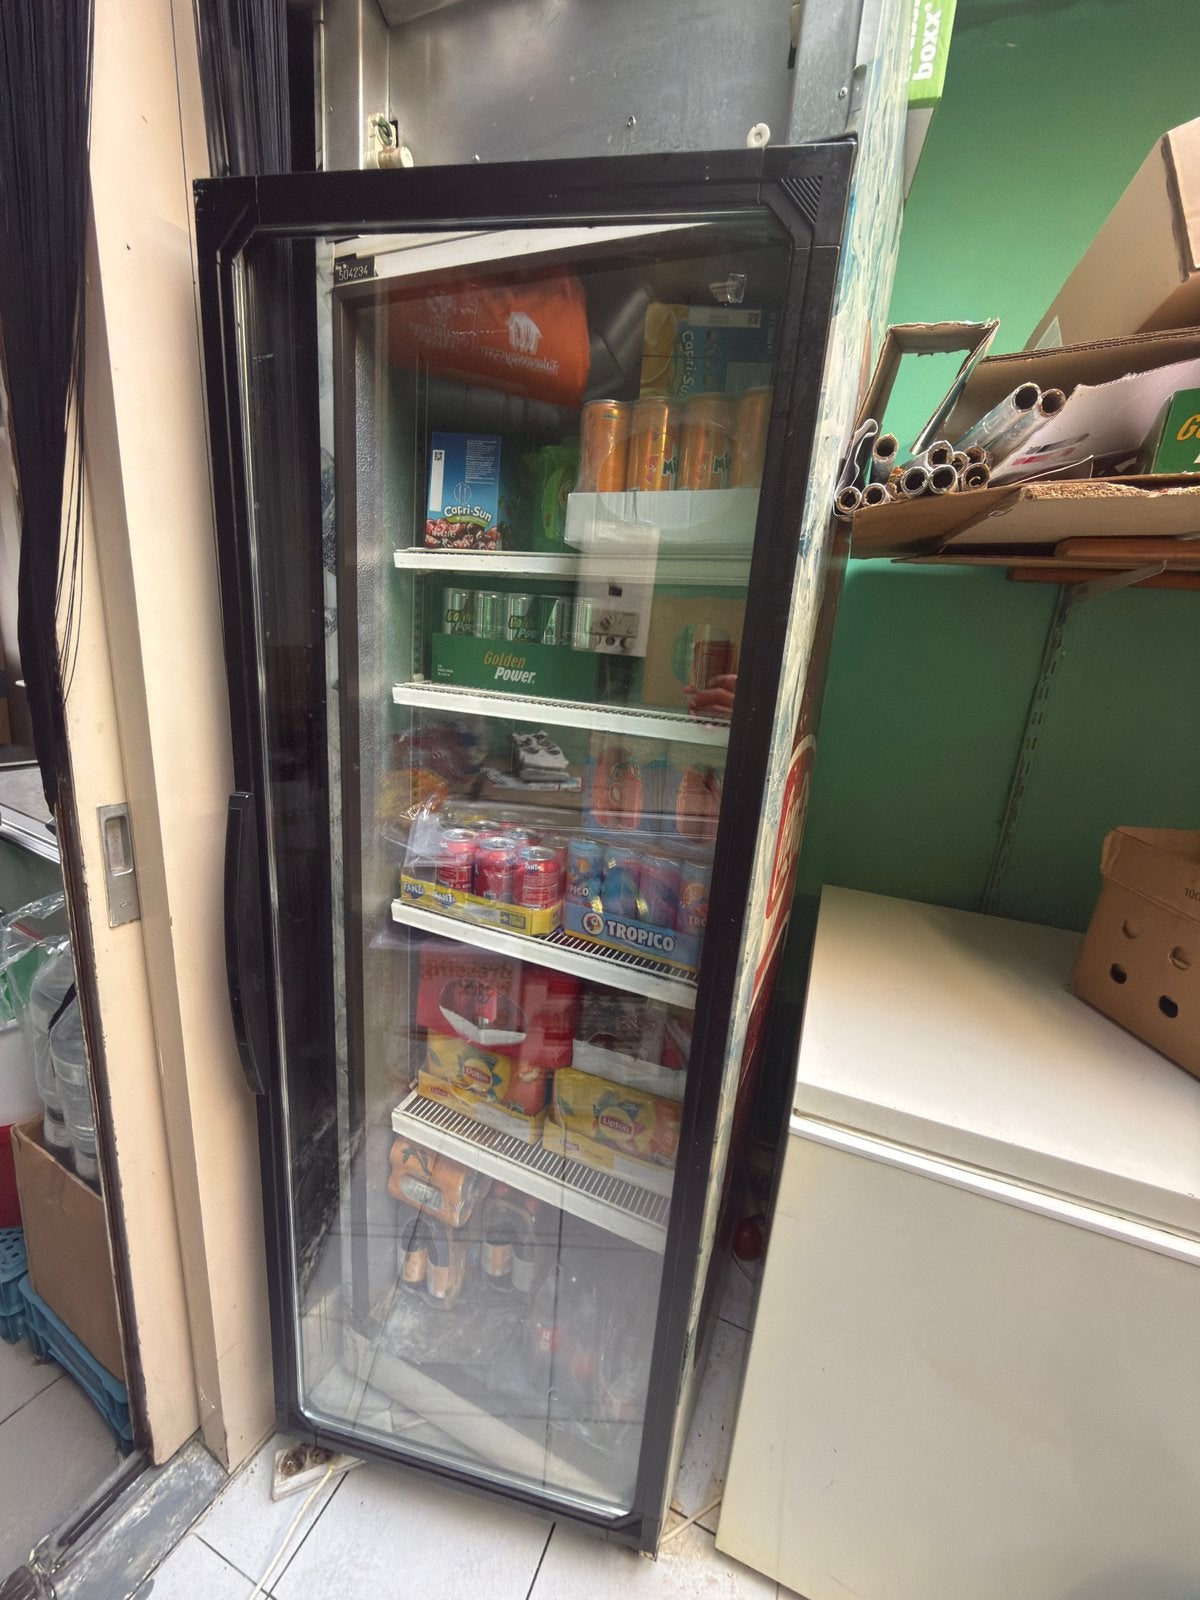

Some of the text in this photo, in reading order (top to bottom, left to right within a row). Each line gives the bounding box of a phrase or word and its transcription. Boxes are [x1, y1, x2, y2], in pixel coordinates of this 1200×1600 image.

[912, 9, 942, 81] boxx
[339, 265, 368, 281] 504234
[444, 504, 493, 522] Capri-Sun
[484, 650, 526, 669] Golden
[494, 665, 537, 684] Power
[606, 919, 676, 952] TROPICO
[465, 1067, 490, 1083] Lipton
[602, 1116, 631, 1134] Lipton
